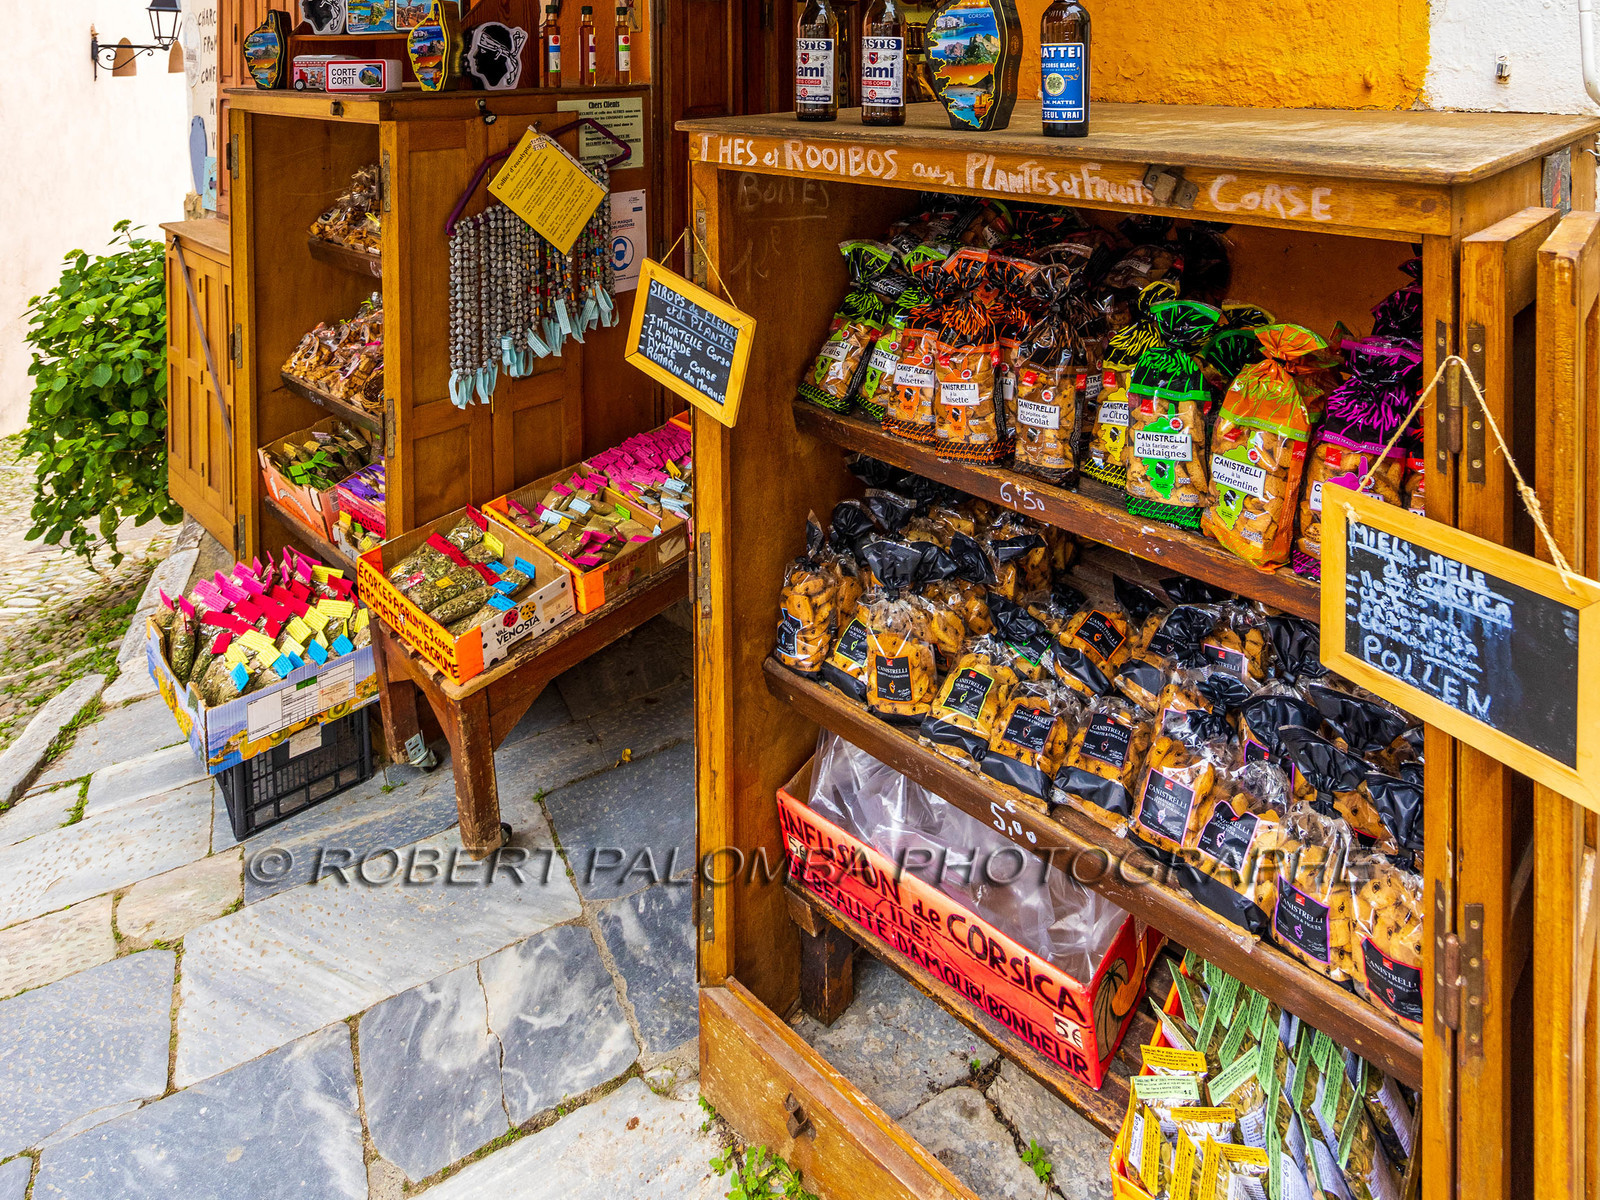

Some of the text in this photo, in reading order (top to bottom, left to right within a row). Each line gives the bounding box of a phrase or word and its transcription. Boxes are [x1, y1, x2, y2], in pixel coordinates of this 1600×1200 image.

[1041, 47, 1080, 58] ATTEI
[331, 67, 357, 77] CORTE
[331, 76, 355, 85] CORTI
[783, 139, 898, 180] ROOIBOS
[912, 162, 955, 186] aux
[496, 171, 511, 190] Collier
[650, 280, 686, 307] SIROPS
[704, 312, 739, 339] FLEURS
[648, 325, 691, 357] LAVANDE
[691, 316, 734, 351] PLANTES
[648, 336, 677, 360] MYRTE
[647, 346, 683, 376] ROMARIN
[684, 371, 695, 385] du
[1018, 400, 1057, 414] CANISTRELLI
[1109, 411, 1129, 420] Citro
[1020, 414, 1050, 426] Chocolat
[1136, 432, 1188, 444] CANISTRELLI
[1137, 446, 1187, 459] Châtaignes
[1214, 456, 1262, 478] CANISTRELLI
[1212, 470, 1259, 493] Clémentine
[360, 583, 405, 634] AROMATES
[393, 597, 434, 641] AGRUMES
[495, 627, 507, 637] VAL
[496, 615, 540, 645] VENOSTA
[1363, 634, 1492, 716] POLLEN
[1091, 724, 1128, 739] CANISTRELLI
[1149, 783, 1187, 810] CANISTRELLI
[778, 799, 1087, 1023] INFUSION de CORSICA
[1280, 893, 1323, 924] CANISTRELLI
[1365, 956, 1417, 989] CANISTRELLI
[1055, 1017, 1083, 1050] 5€
